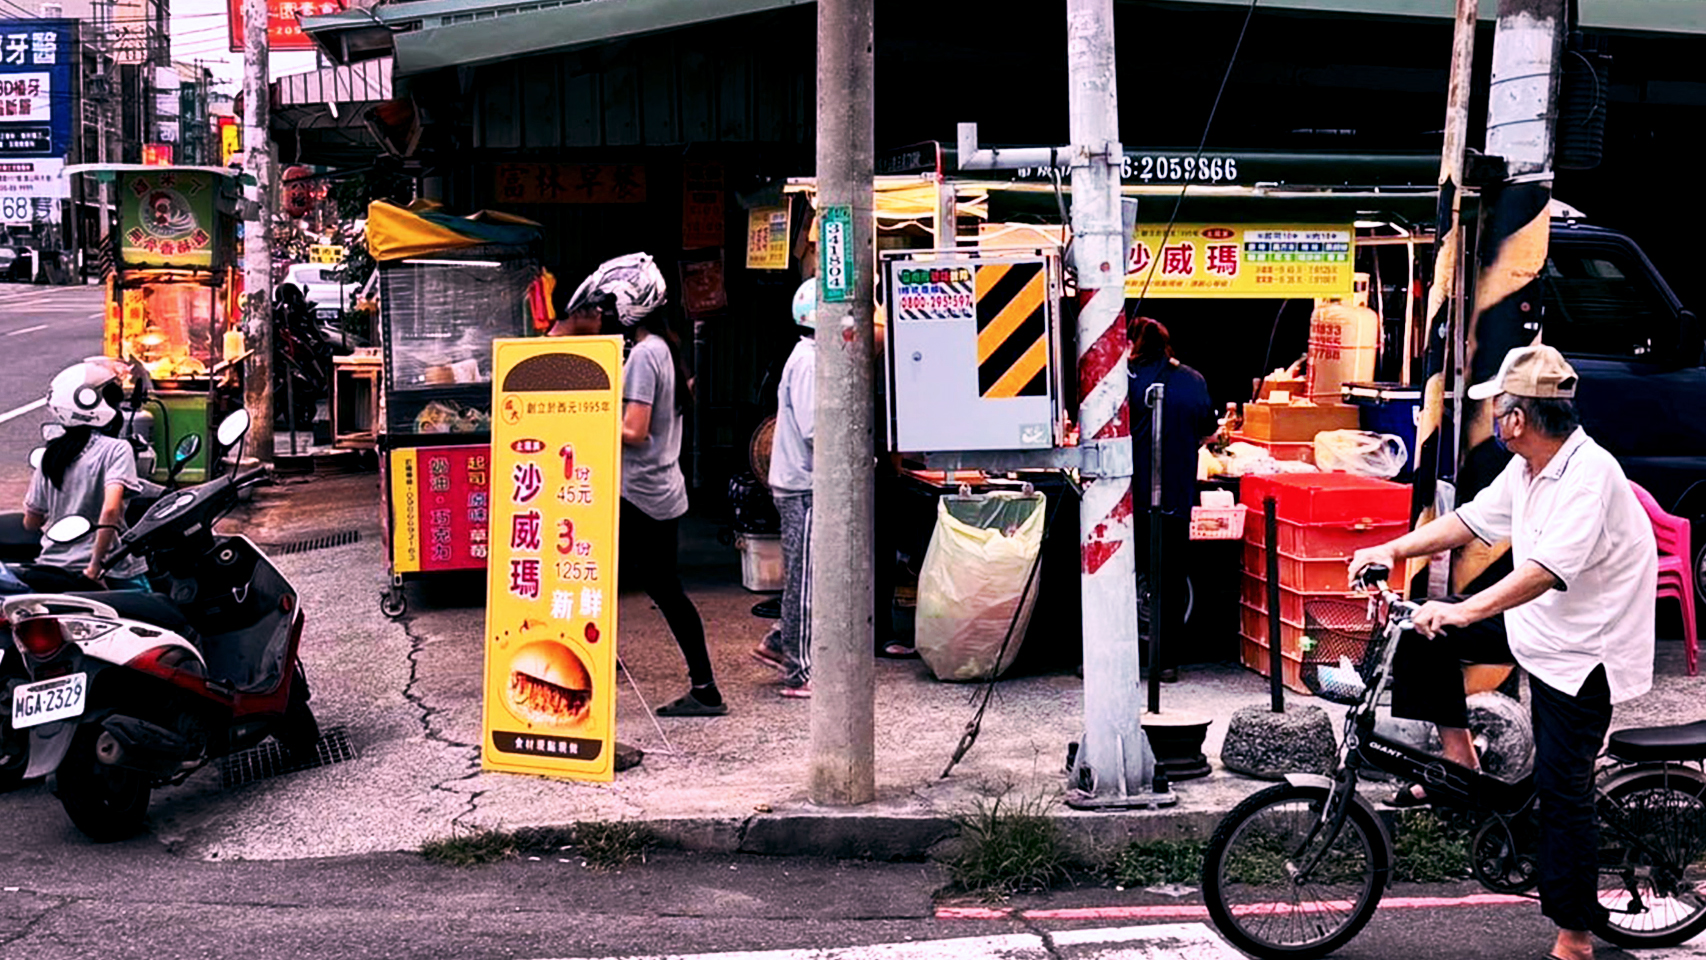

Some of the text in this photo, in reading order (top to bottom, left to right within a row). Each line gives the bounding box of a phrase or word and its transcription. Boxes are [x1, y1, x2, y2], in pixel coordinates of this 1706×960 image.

[0, 32, 57, 64] 牙醫
[429, 456, 452, 561] 奶油 巧克力
[557, 486, 592, 504] 45元
[510, 463, 542, 599] 沙威瑪
[556, 519, 591, 557] 3份
[555, 561, 598, 581] 125元
[550, 586, 602, 620] 新鮮
[15, 684, 82, 718] MGA-2329
[1368, 741, 1402, 758] GIANT
